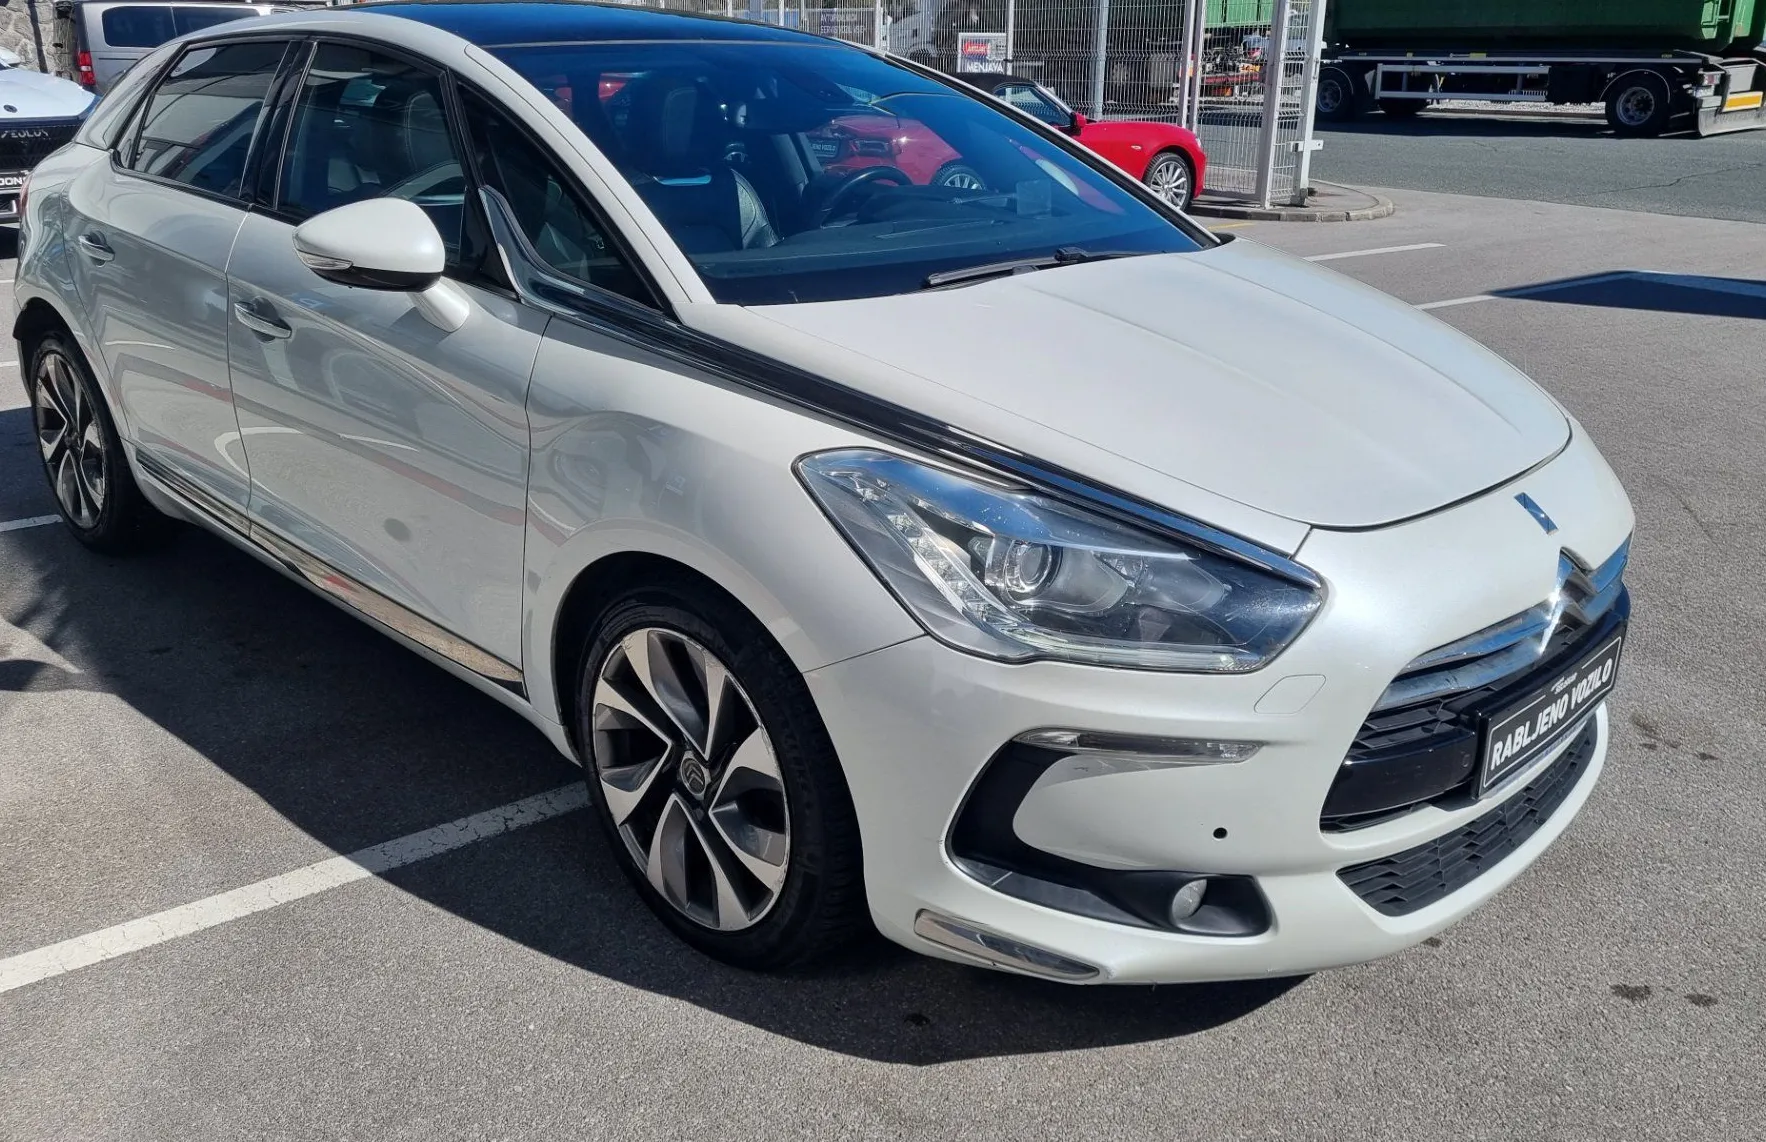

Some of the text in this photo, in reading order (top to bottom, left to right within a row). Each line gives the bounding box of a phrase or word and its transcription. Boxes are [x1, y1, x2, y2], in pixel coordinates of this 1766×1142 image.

[0, 176, 26, 186] DON
[1490, 657, 1613, 771] RABLJENO VOZILO
